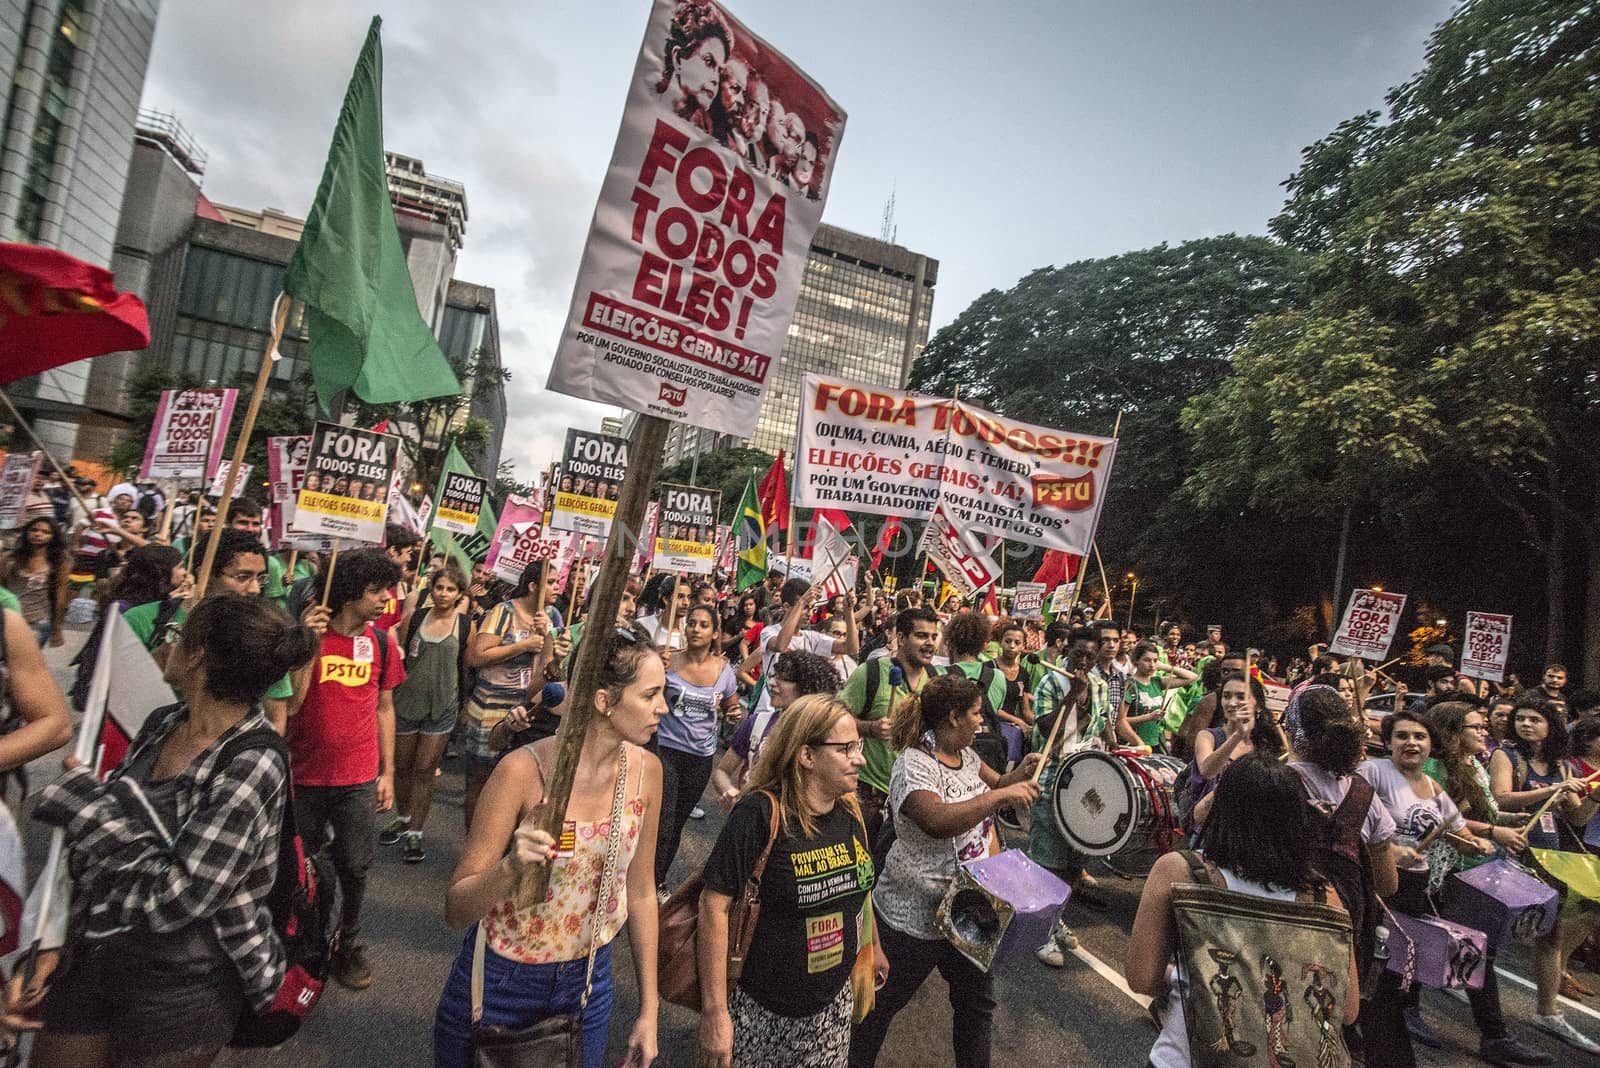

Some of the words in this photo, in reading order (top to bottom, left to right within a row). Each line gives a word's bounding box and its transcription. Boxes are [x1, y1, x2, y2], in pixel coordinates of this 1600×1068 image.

[637, 118, 787, 256] FORA
[631, 187, 779, 299] TODOS
[632, 253, 755, 340] ELES!
[590, 302, 680, 348] ELEIÇÕES
[680, 334, 740, 369] GERAIS
[738, 354, 766, 378] JÁ!
[576, 331, 595, 345] POR
[594, 337, 610, 350] UM
[610, 342, 652, 362] GOVERNO
[652, 354, 692, 375] SOCIALISTA
[693, 367, 708, 380] DOS
[707, 372, 761, 397] TRABALHADORES
[603, 351, 643, 371] APOIADO
[643, 363, 656, 374] EM
[655, 367, 697, 387] CONSELHOS
[697, 379, 736, 399] POPULARES!
[661, 388, 683, 401] PSTU
[168, 412, 212, 427] FORA
[813, 381, 917, 427] FORA
[932, 402, 1105, 468] TODOS!!!
[166, 428, 209, 441] TODOS
[167, 441, 202, 453] ELES!
[321, 431, 387, 465] FORA
[572, 436, 629, 468] FORA
[815, 421, 867, 444] (DILMA,
[871, 431, 921, 452] CUNHA,
[924, 438, 963, 458] AÉCIO
[965, 448, 976, 461] E
[979, 451, 1032, 478] TEMER)
[316, 456, 356, 474] TODOS
[357, 464, 388, 481] ELES!
[568, 460, 602, 477] TODOS
[807, 447, 903, 475] ELEIÇÕES
[908, 462, 986, 494] GERAIS,
[990, 480, 1026, 501] JÁ!
[445, 489, 466, 501] TODOS
[448, 475, 482, 496] FORA
[1036, 481, 1090, 502] PSTU
[666, 490, 713, 514] FORA
[809, 473, 838, 486] POR
[842, 477, 865, 490] UM
[868, 481, 941, 500] GOVERNO
[942, 490, 1026, 521] SOCIALISTA
[1028, 512, 1064, 530] DOS
[815, 487, 936, 512] TRABALHADORE
[663, 510, 691, 524] TODOS
[512, 535, 559, 560] TODOS
[1017, 601, 1041, 610] GERAL
[1019, 593, 1042, 602] GREVE
[1347, 620, 1388, 635] TODOS
[1350, 609, 1390, 625] FORA
[1347, 629, 1382, 641] ELES!
[1469, 631, 1503, 645] FORA
[1469, 641, 1502, 654] TODOS
[326, 663, 367, 678] PSTU
[793, 863, 815, 877] MAL
[816, 860, 829, 873] AO
[827, 853, 853, 870] BRASIL
[797, 882, 822, 895] CONTRA
[822, 880, 827, 890] A
[798, 892, 821, 905] ATIVOS
[811, 917, 839, 935] FORA
